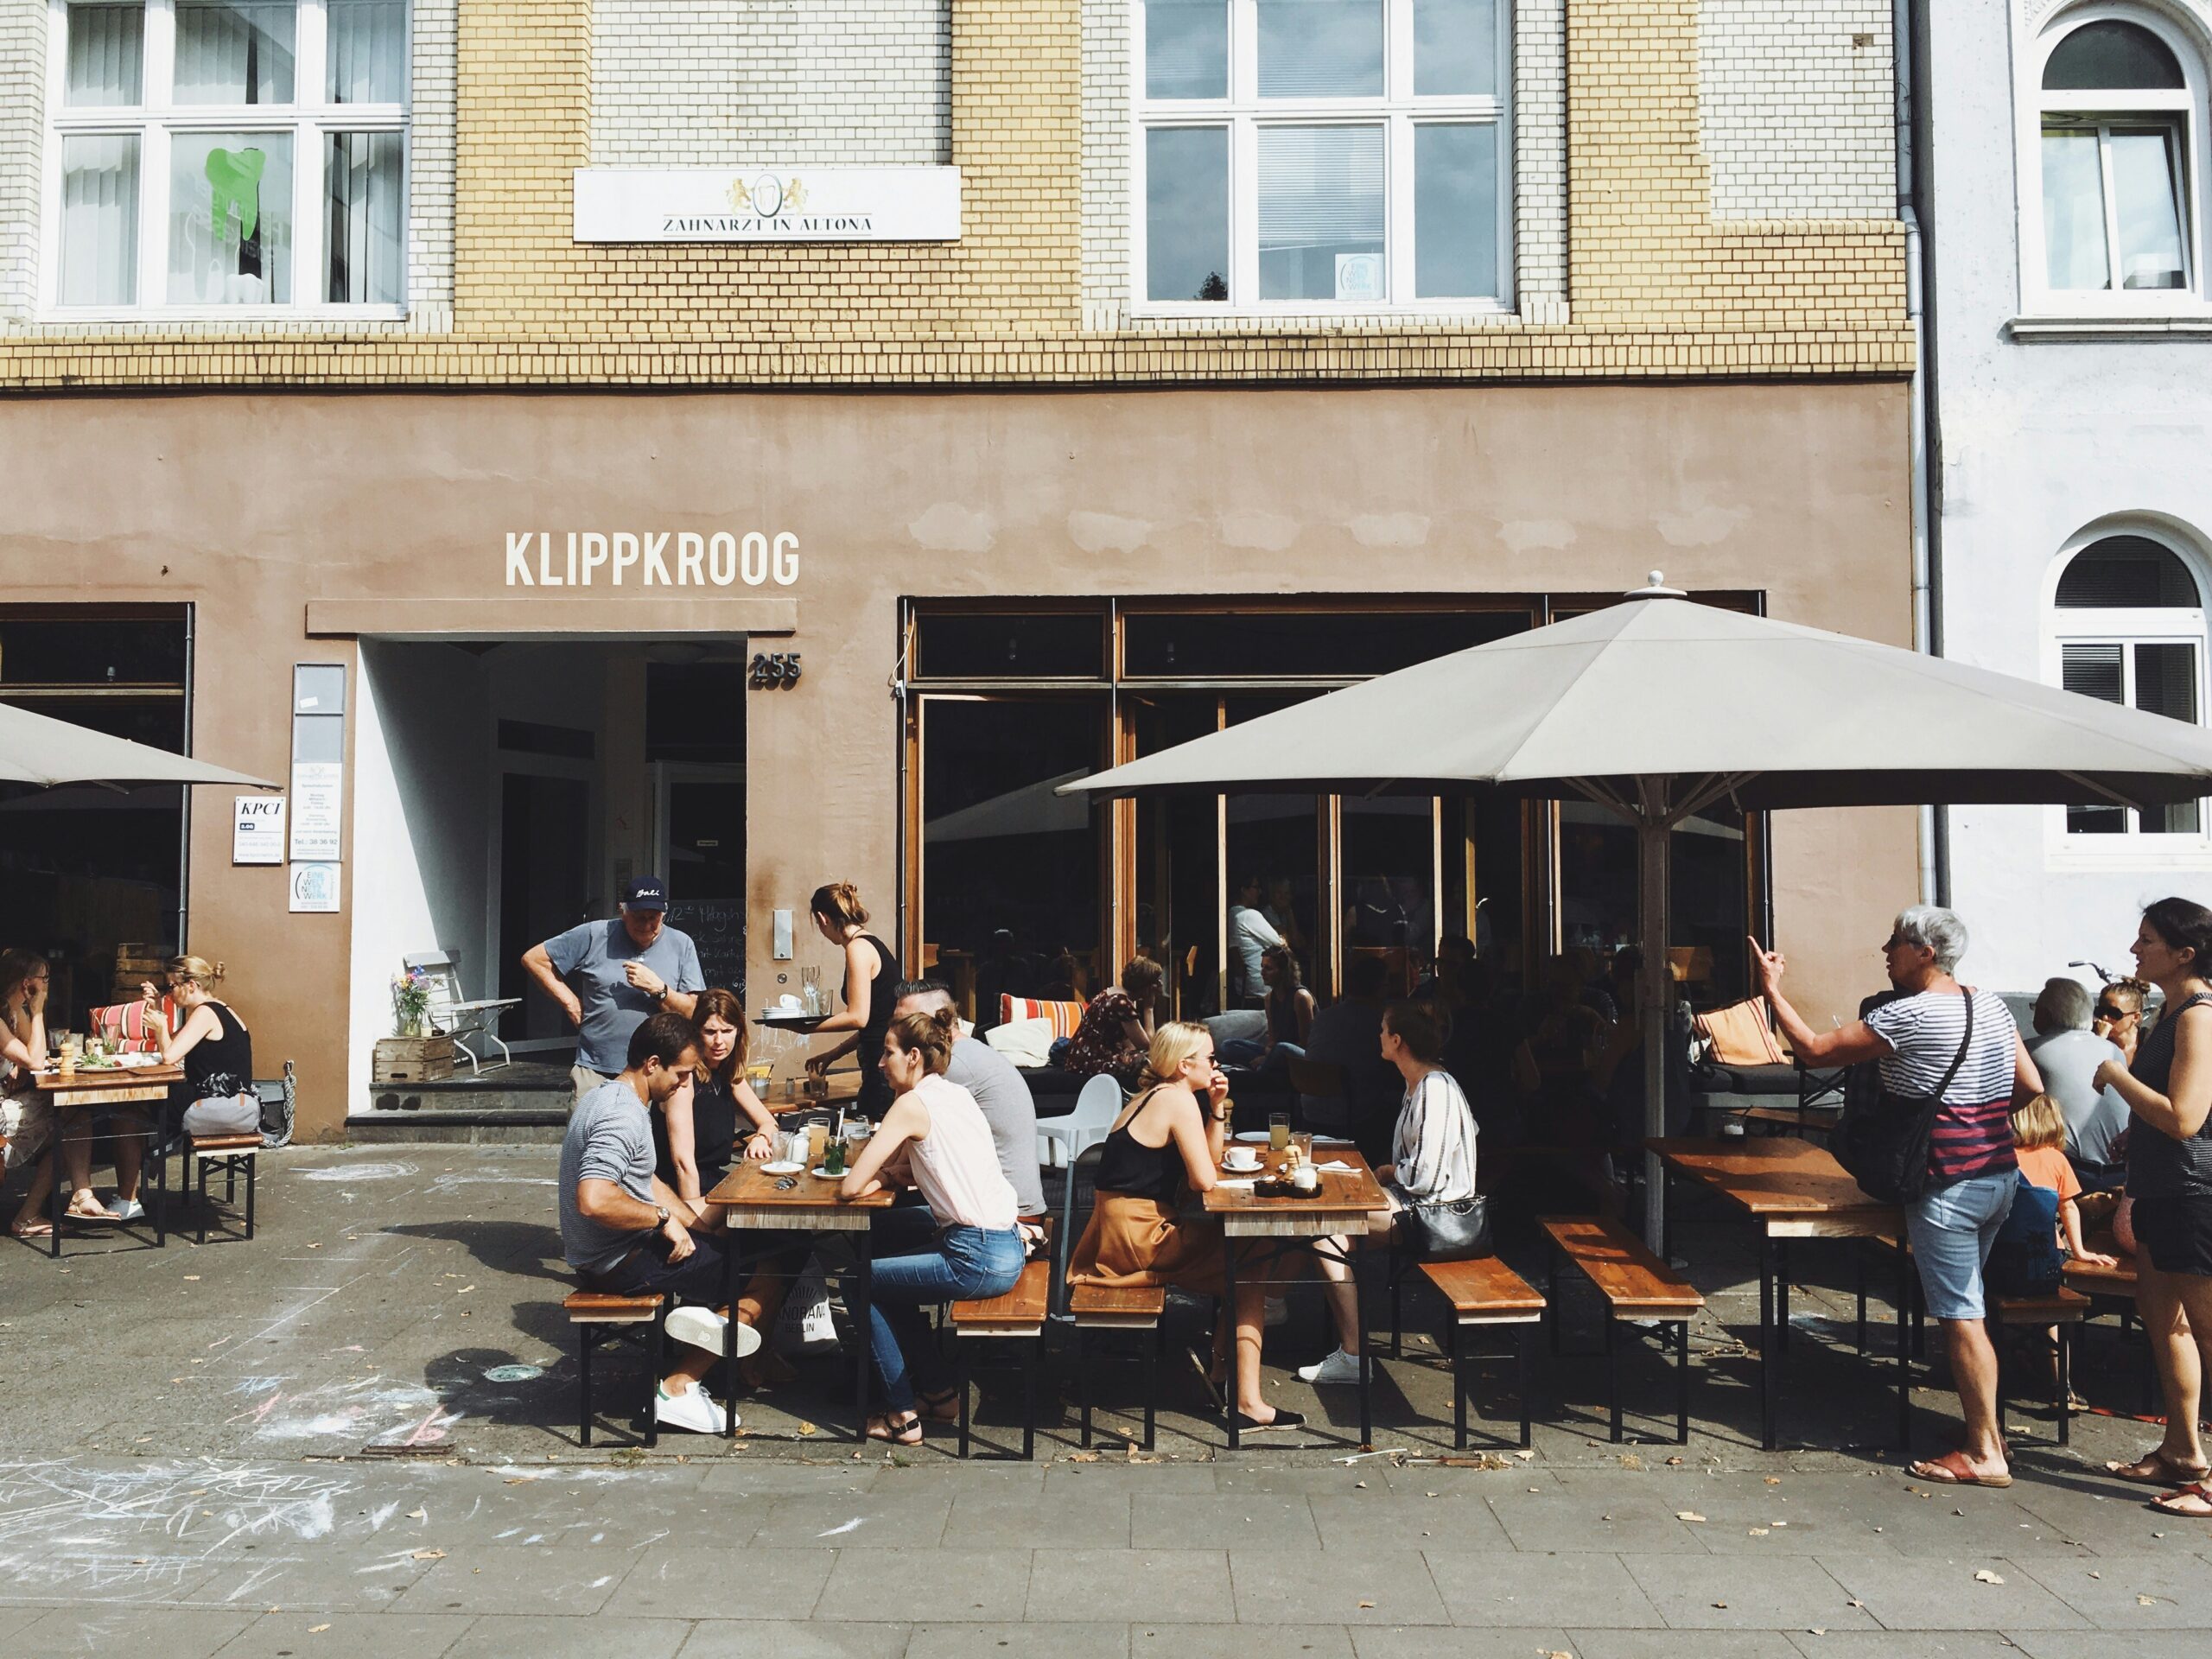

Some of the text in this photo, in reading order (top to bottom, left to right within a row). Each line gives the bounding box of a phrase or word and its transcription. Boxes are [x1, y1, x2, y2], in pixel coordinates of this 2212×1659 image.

[664, 218, 872, 232] ZAHNARZT IN ALTONA
[505, 531, 800, 586] KLIPPKROOG
[753, 652, 802, 679] 255
[241, 803, 281, 815] KPCI
[785, 1323, 815, 1333] BERLIN
